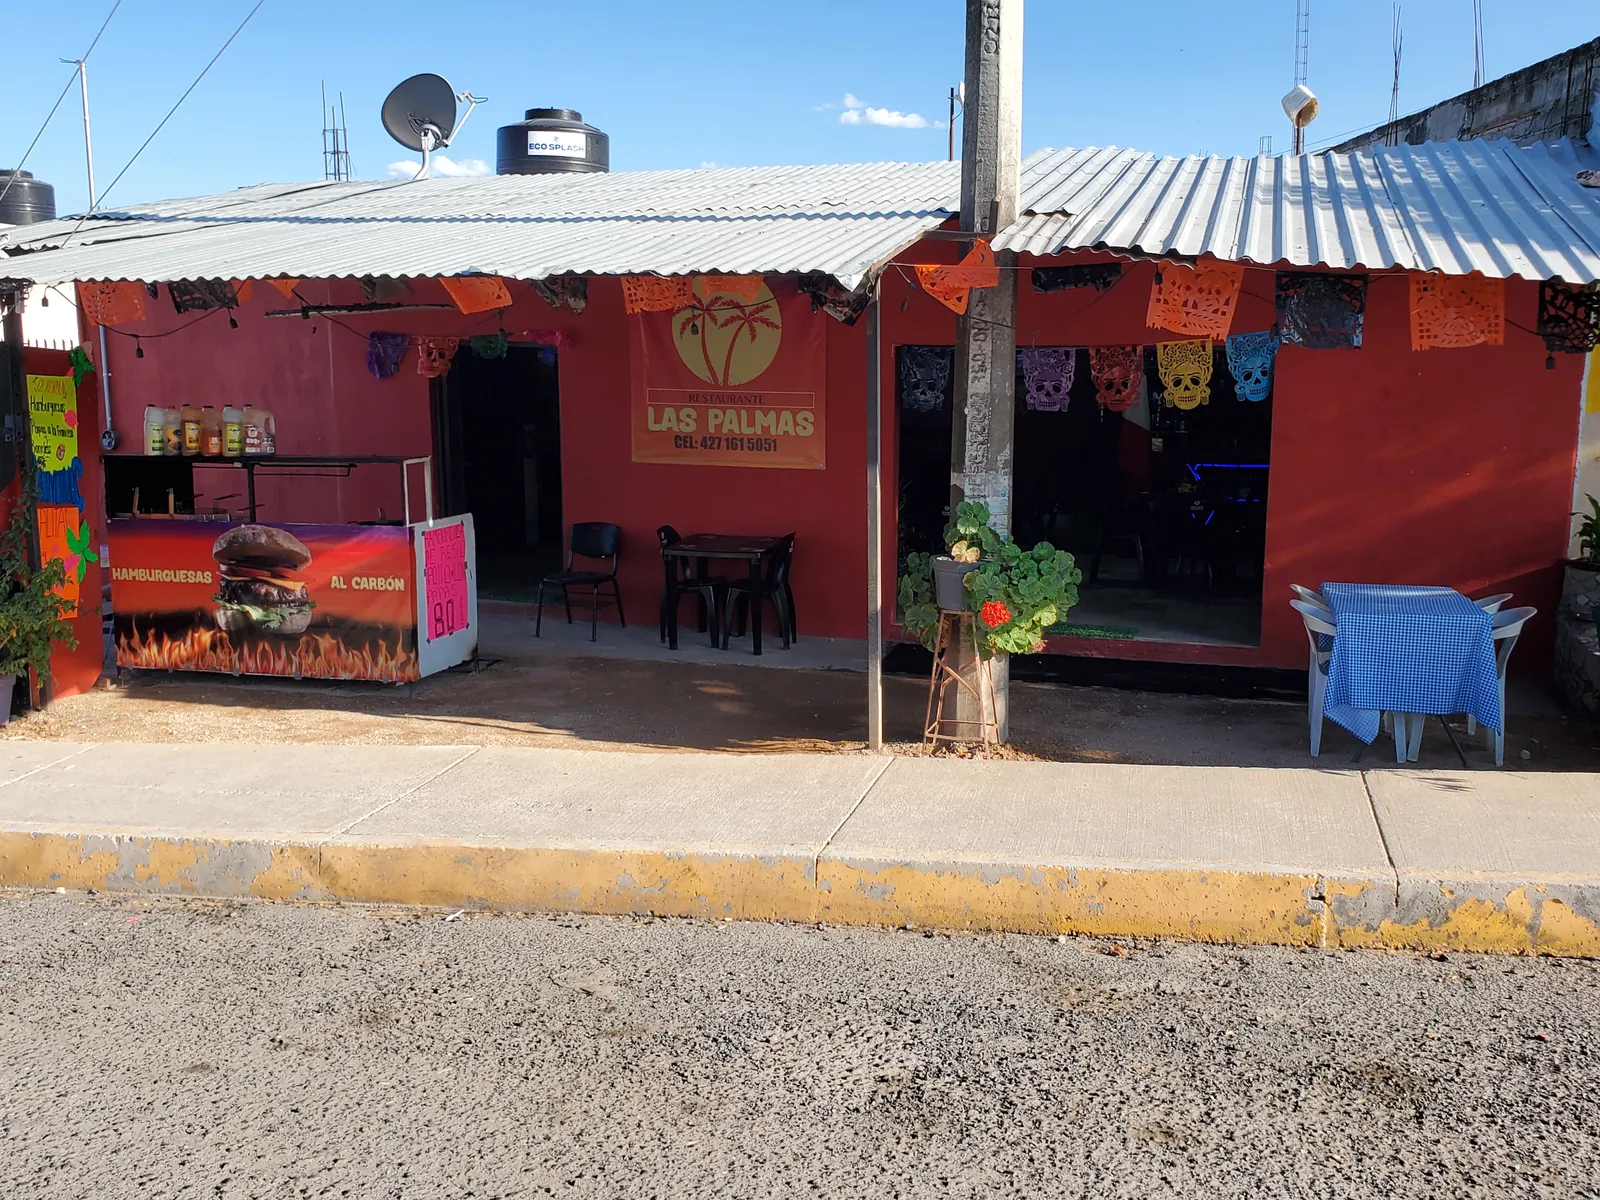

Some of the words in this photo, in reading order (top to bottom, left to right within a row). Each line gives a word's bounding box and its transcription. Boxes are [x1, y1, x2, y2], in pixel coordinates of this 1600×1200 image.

[549, 143, 584, 152] SPLASH
[688, 393, 765, 405] RESTAURANTE
[647, 406, 698, 433] LAS
[708, 408, 815, 437] PALMAS
[674, 435, 698, 450] CEL:
[701, 436, 722, 450] 427
[725, 437, 744, 451] 161
[747, 438, 777, 452] 5051
[440, 544, 460, 562] RES
[112, 567, 213, 584] HAMBURGUESAS
[330, 576, 347, 590] AL
[351, 575, 405, 591] CARBÓN
[427, 584, 458, 606] PAPAS
[433, 598, 455, 638] 80
